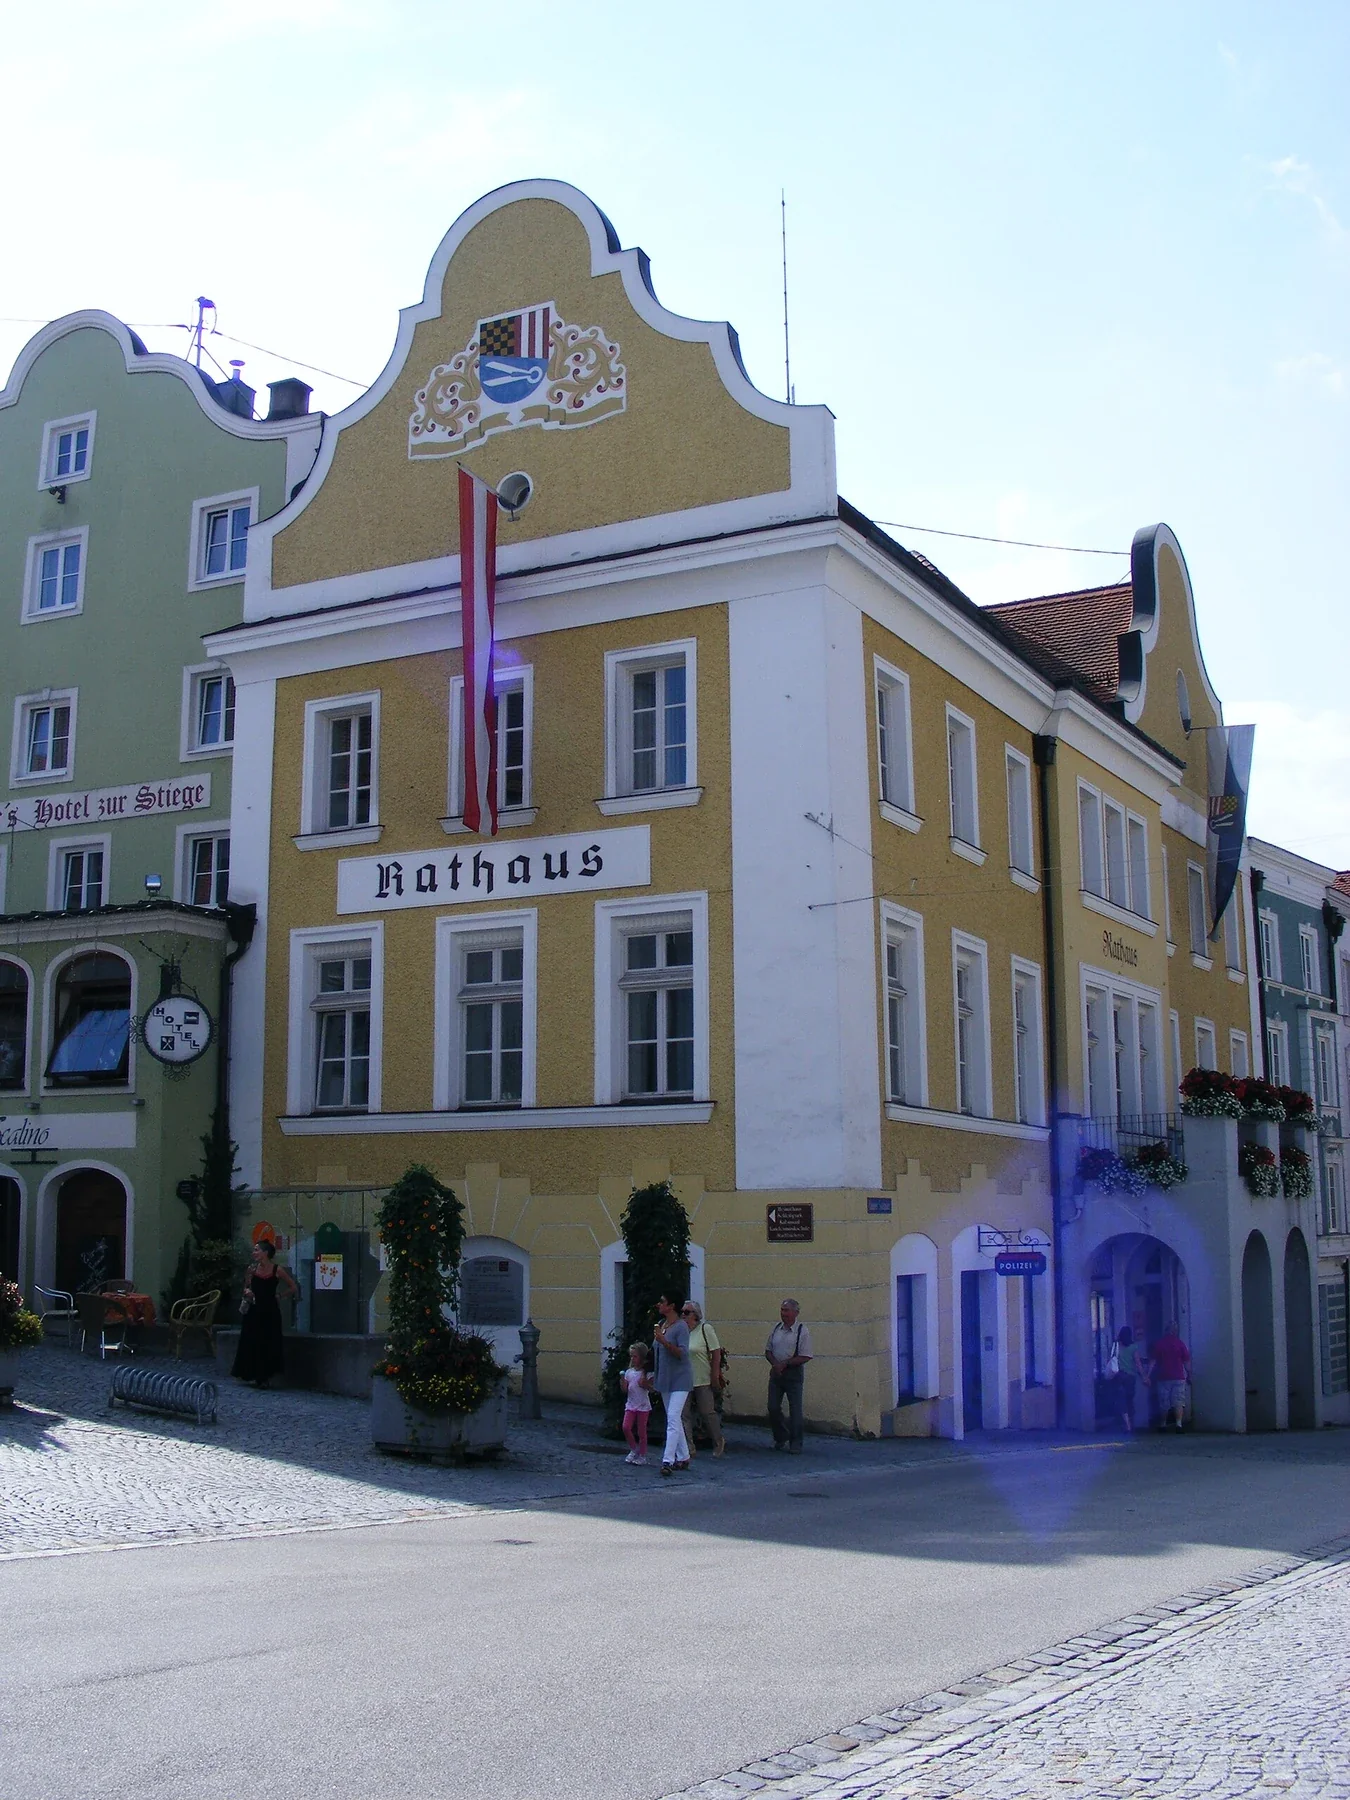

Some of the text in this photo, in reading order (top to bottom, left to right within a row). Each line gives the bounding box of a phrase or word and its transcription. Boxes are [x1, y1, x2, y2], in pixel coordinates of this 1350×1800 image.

[34, 794, 90, 828] Hotel
[98, 795, 128, 820] zur
[133, 783, 205, 813] Stiege
[374, 844, 604, 899] Rathaus
[1102, 930, 1138, 967] Rathaus
[155, 1007, 200, 1047] HOTEL
[999, 1262, 1033, 1270] POLIZEI
